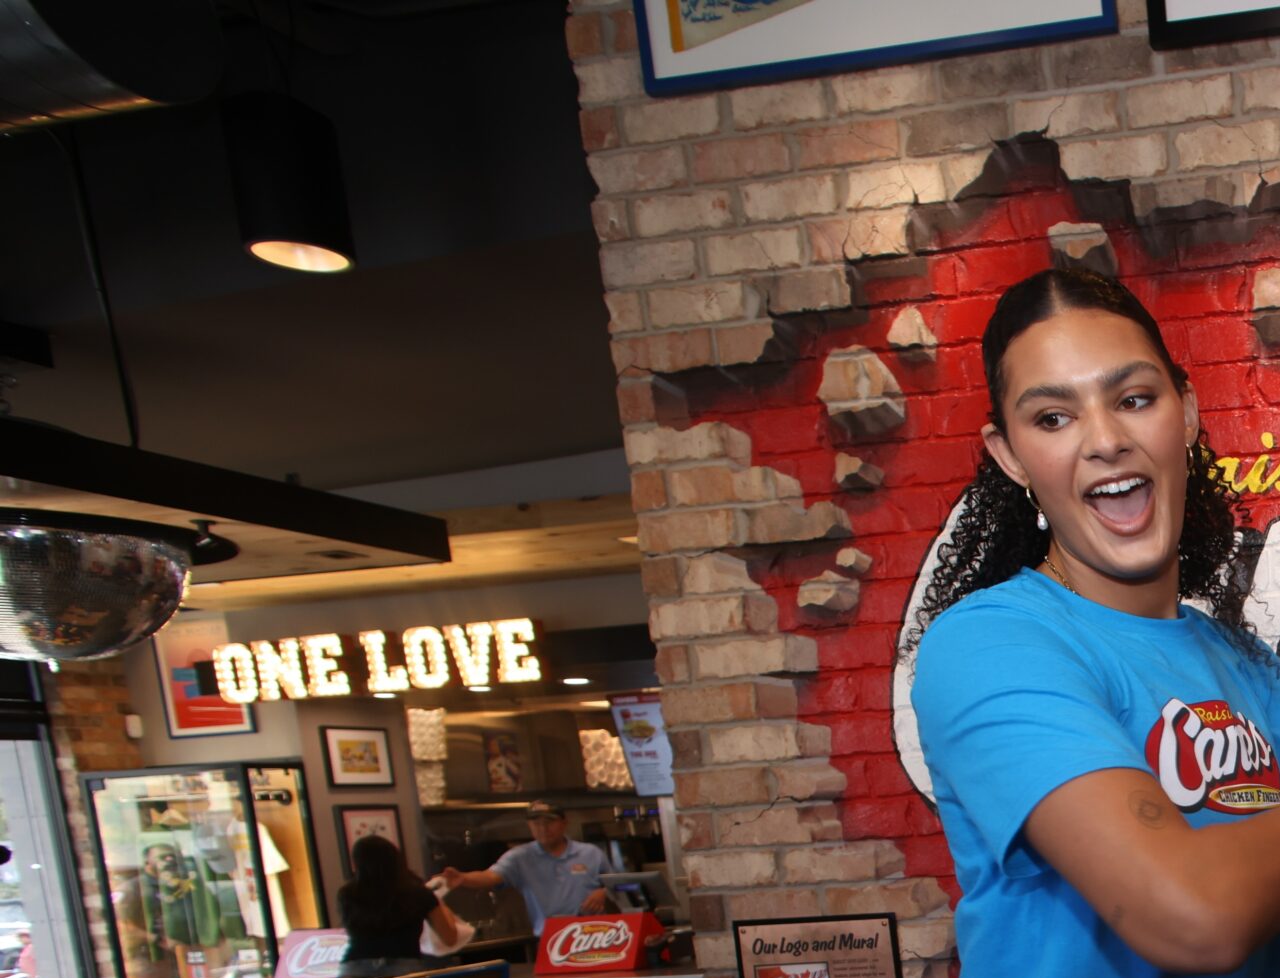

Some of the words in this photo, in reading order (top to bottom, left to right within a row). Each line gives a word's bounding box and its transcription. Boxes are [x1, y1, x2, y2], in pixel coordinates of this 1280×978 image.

[212, 632, 351, 704] ONE
[358, 617, 543, 693] LOVE
[551, 920, 631, 963] Cane's
[753, 938, 777, 955] Our
[780, 937, 809, 956] Logo
[812, 936, 836, 952] and
[840, 933, 879, 951] Mural
